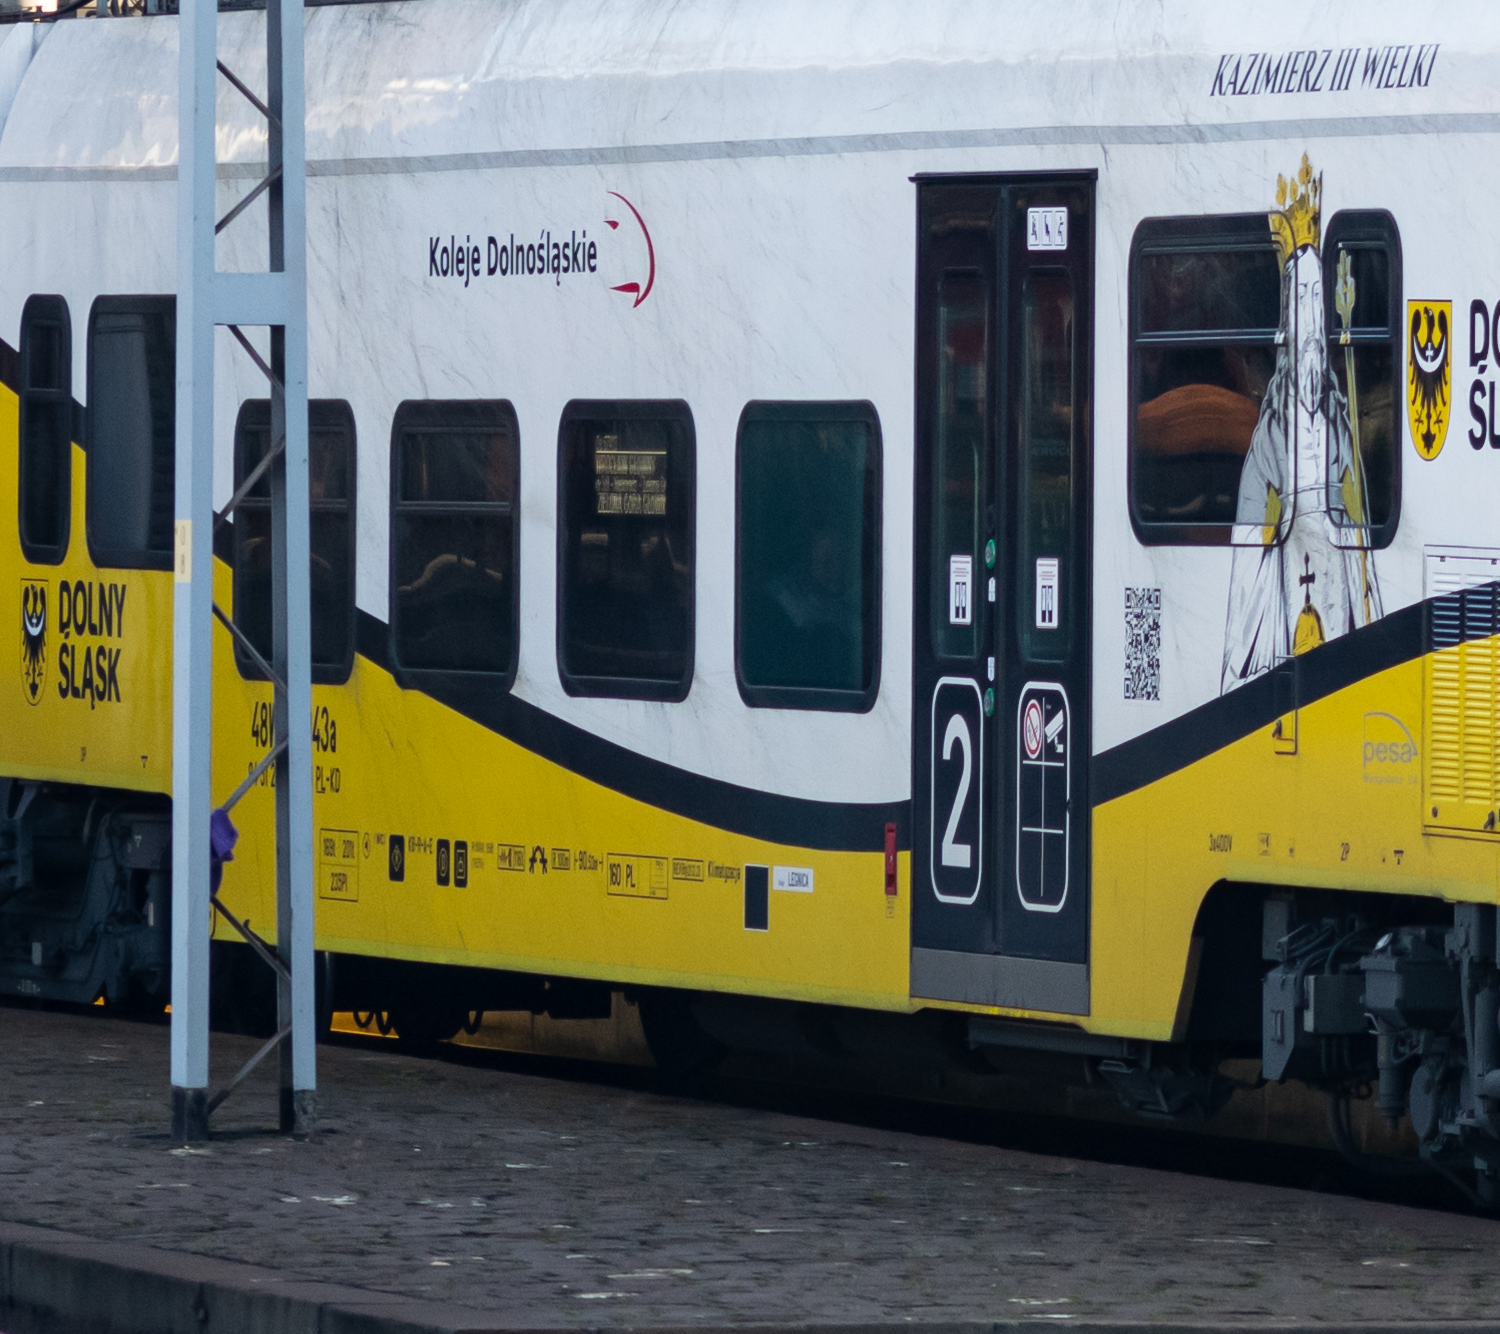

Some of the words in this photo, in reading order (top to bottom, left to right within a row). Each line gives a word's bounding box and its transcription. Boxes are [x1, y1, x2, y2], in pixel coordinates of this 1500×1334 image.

[1209, 49, 1333, 97] KAZIMIERZ
[1328, 47, 1361, 91] III
[1360, 43, 1441, 90] WIELKI
[428, 234, 481, 288] Koleje
[487, 229, 597, 287] Dolnośląskie
[57, 580, 127, 639] DOLNY
[57, 631, 122, 710] ŚLĄSK
[1363, 740, 1414, 768] pesa
[941, 713, 972, 868] 2
